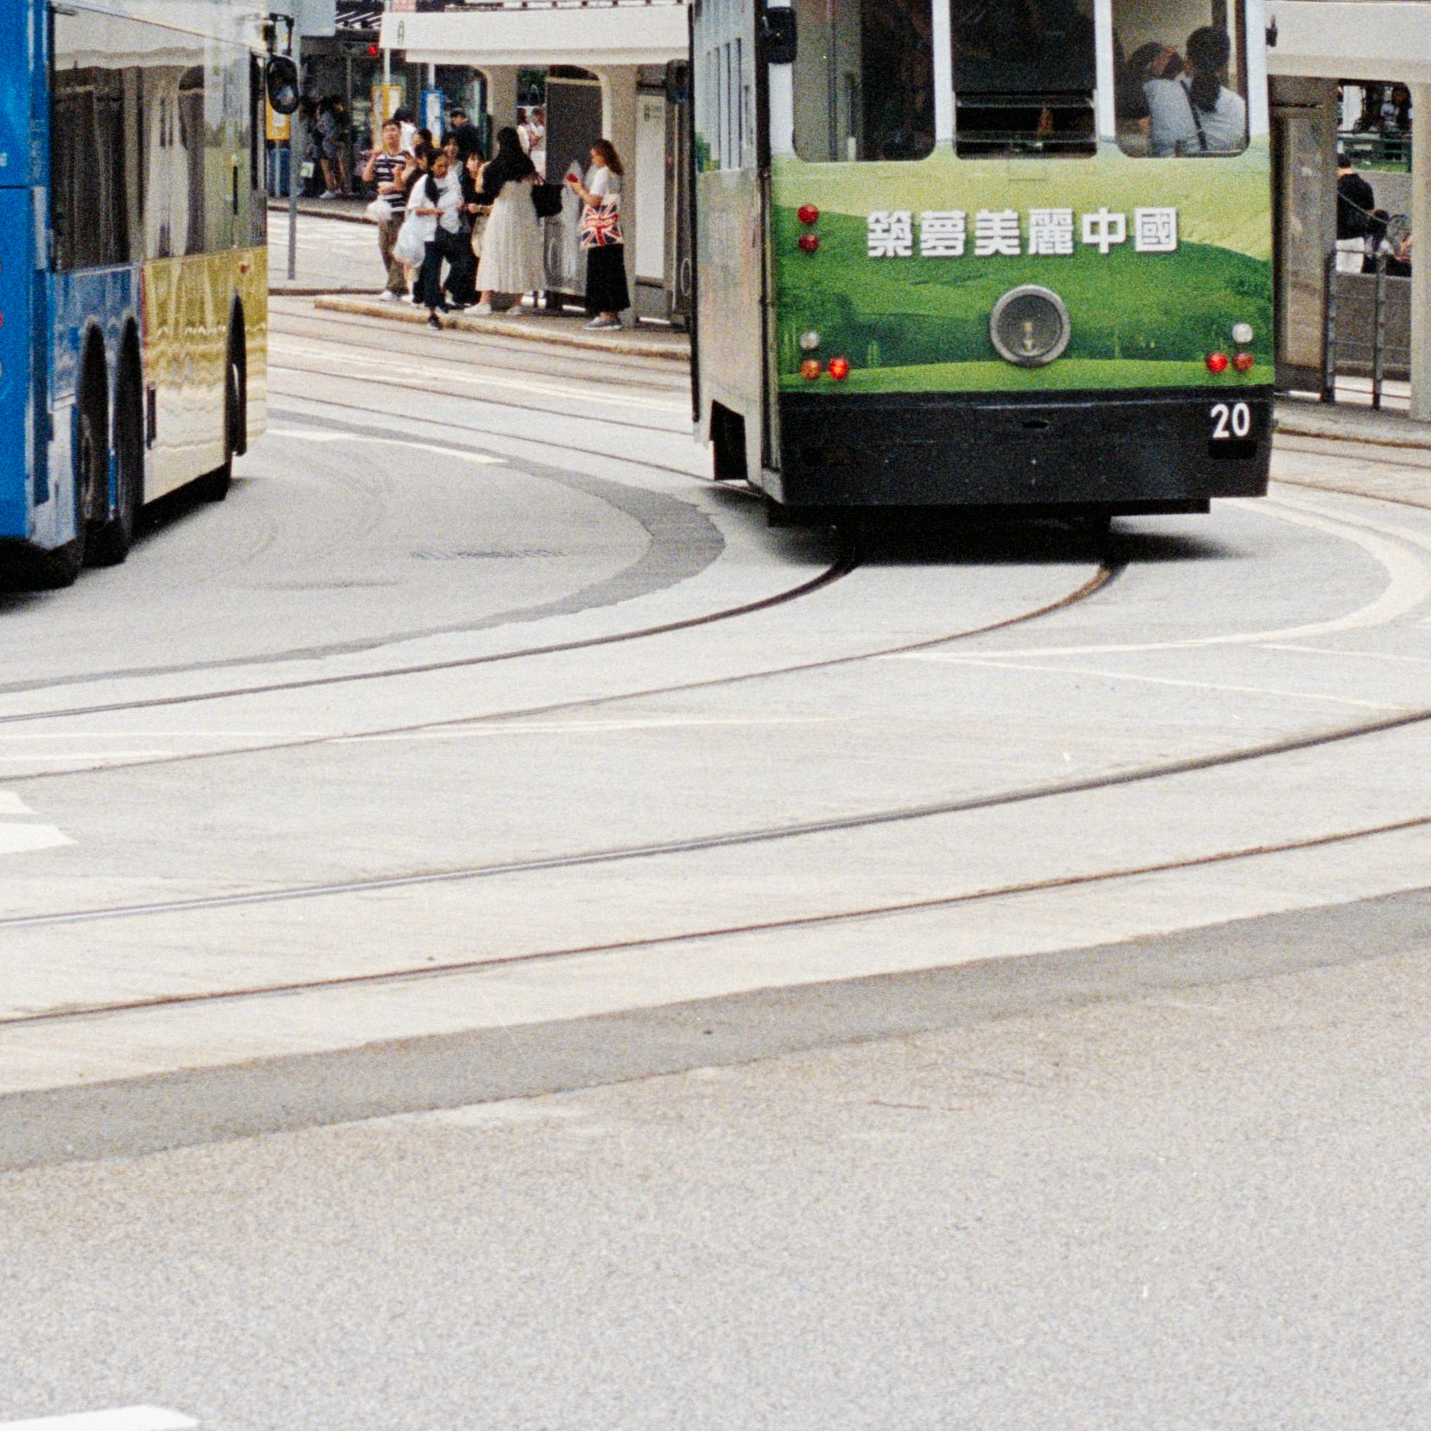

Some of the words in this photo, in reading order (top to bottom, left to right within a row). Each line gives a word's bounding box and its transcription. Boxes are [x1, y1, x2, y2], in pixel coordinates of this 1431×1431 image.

[868, 207, 1177, 257] 築夢美麗中國
[1211, 402, 1250, 438] 20
